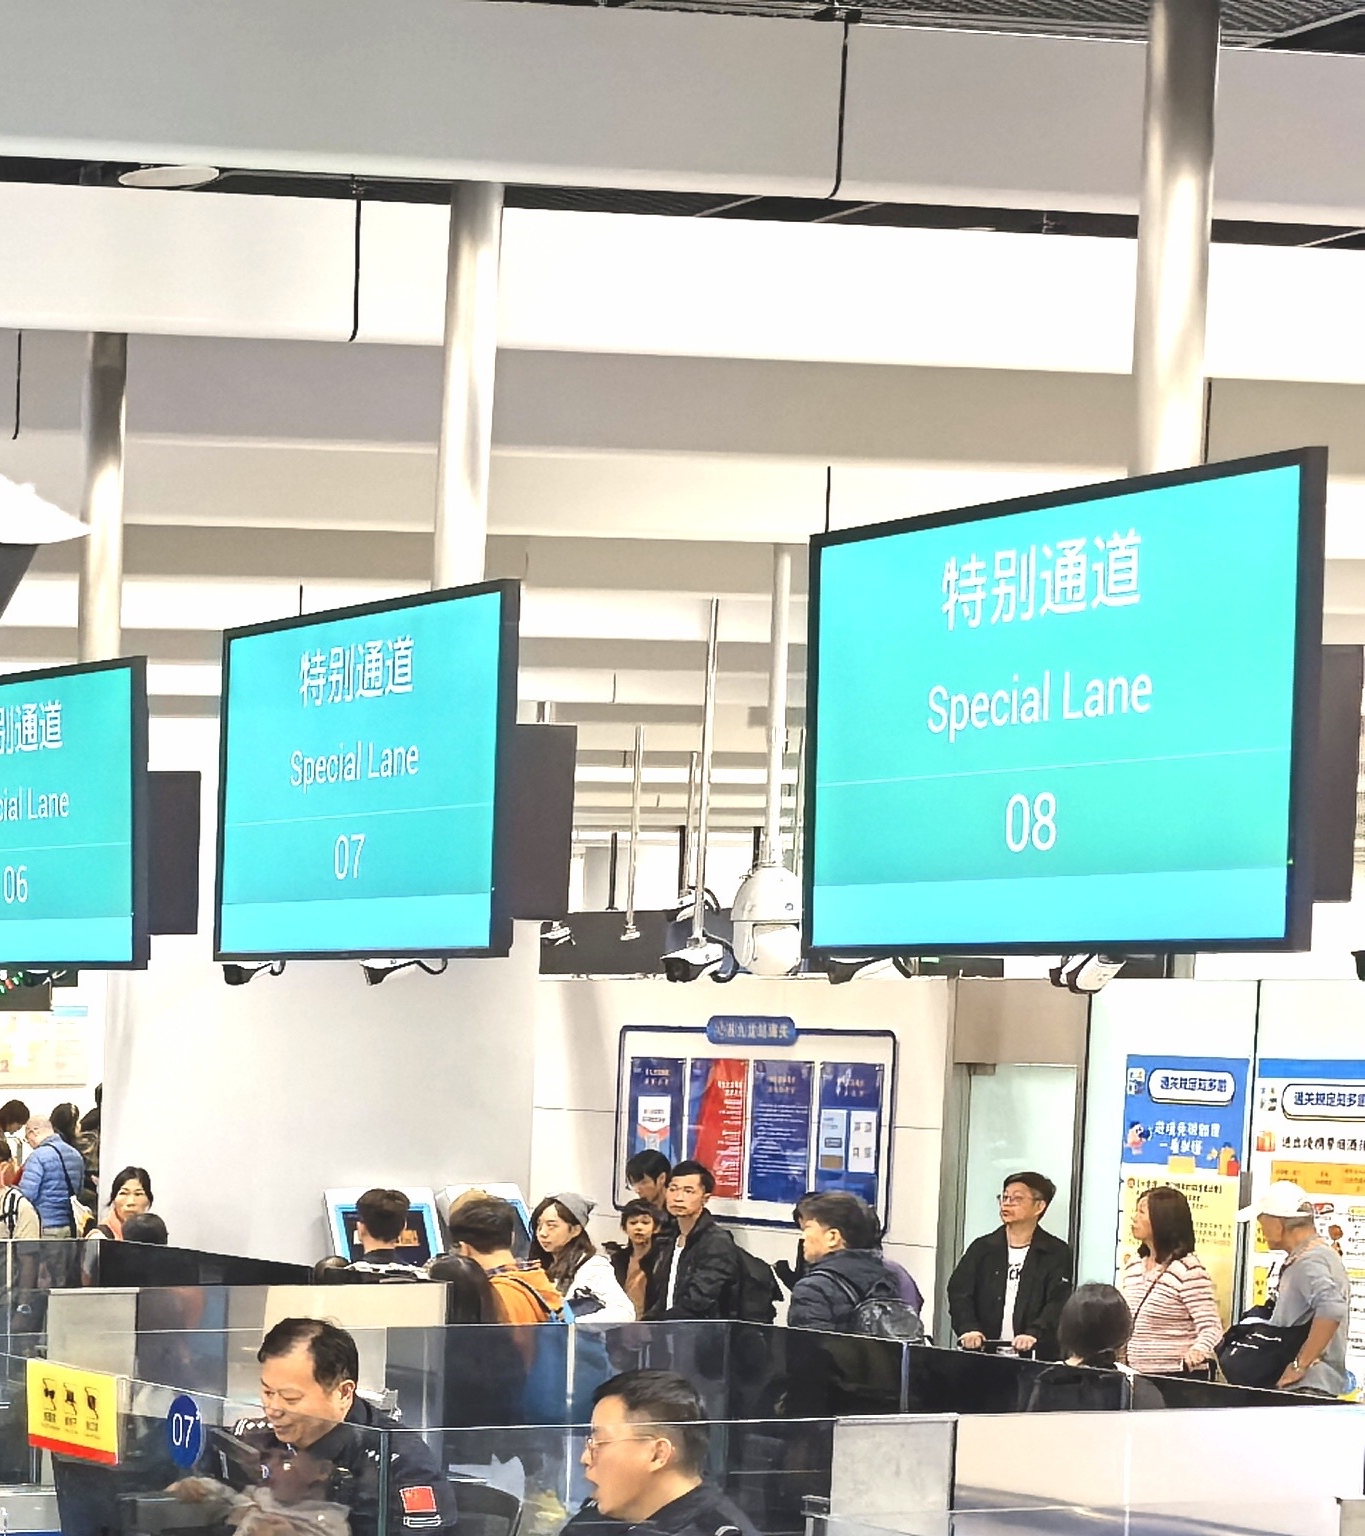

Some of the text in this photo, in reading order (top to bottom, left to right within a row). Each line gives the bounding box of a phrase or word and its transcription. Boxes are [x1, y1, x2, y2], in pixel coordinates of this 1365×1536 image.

[941, 528, 1141, 631] 特别通道
[299, 634, 414, 708] 特别通道
[927, 670, 1153, 743] Special Lane
[290, 740, 419, 794] Special Lane
[27, 788, 69, 819] Lane
[1005, 792, 1056, 852] 08
[334, 833, 366, 880] 07
[3, 865, 28, 904] 06
[172, 1413, 194, 1448] 07
